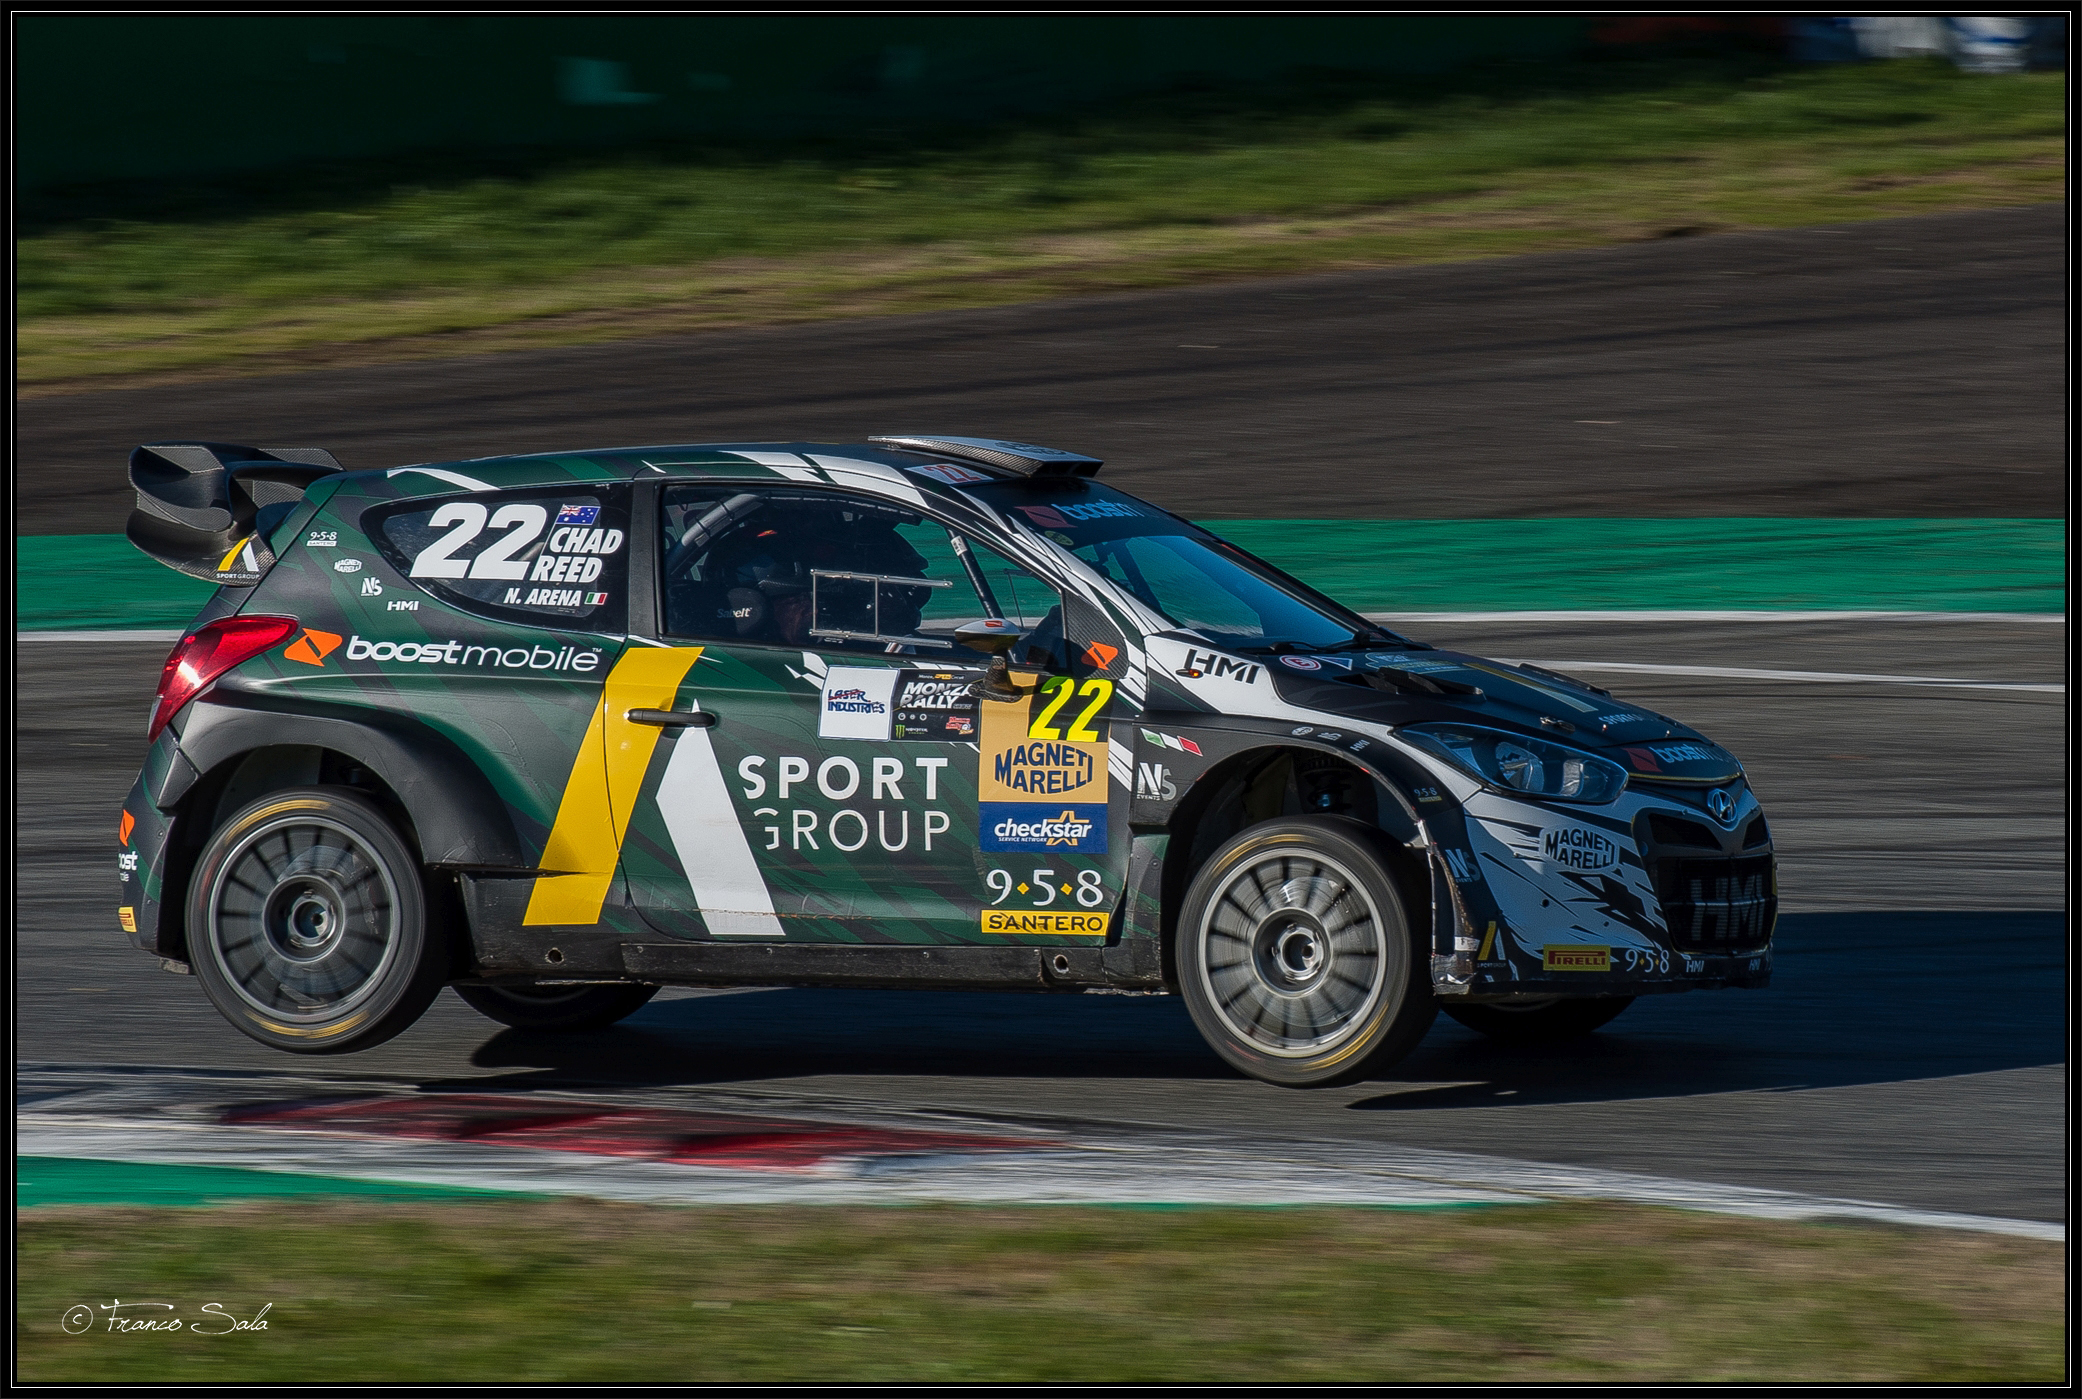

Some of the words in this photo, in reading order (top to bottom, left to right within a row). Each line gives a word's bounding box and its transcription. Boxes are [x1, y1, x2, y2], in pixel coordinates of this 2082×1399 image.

[409, 502, 547, 581] 22
[549, 527, 623, 554] CHAD
[530, 555, 603, 583] REED
[387, 601, 419, 611] HMI
[503, 587, 521, 604] N.
[524, 588, 582, 607] ARENA
[716, 607, 751, 618] Sabelt
[1184, 648, 1261, 685] HMI
[827, 702, 885, 714] INDUSTRIES
[828, 688, 868, 702] LASER
[900, 695, 960, 709] RALLY
[1028, 676, 1113, 743] 22
[995, 743, 1093, 774] MAGNETI
[737, 755, 949, 801] SPORT
[995, 760, 1093, 794] MARELLI
[1137, 762, 1177, 801] NS
[754, 807, 950, 852] GROUP
[994, 818, 1092, 838] checkstar
[1545, 828, 1615, 855] MAGNETI
[1445, 848, 1481, 881] NS
[1545, 845, 1615, 870] MARELLI
[1690, 874, 1765, 941] HMI
[989, 914, 1103, 932] SANTERO
[1548, 950, 1606, 966] PIRELLI
[1686, 960, 1705, 973] HMI
